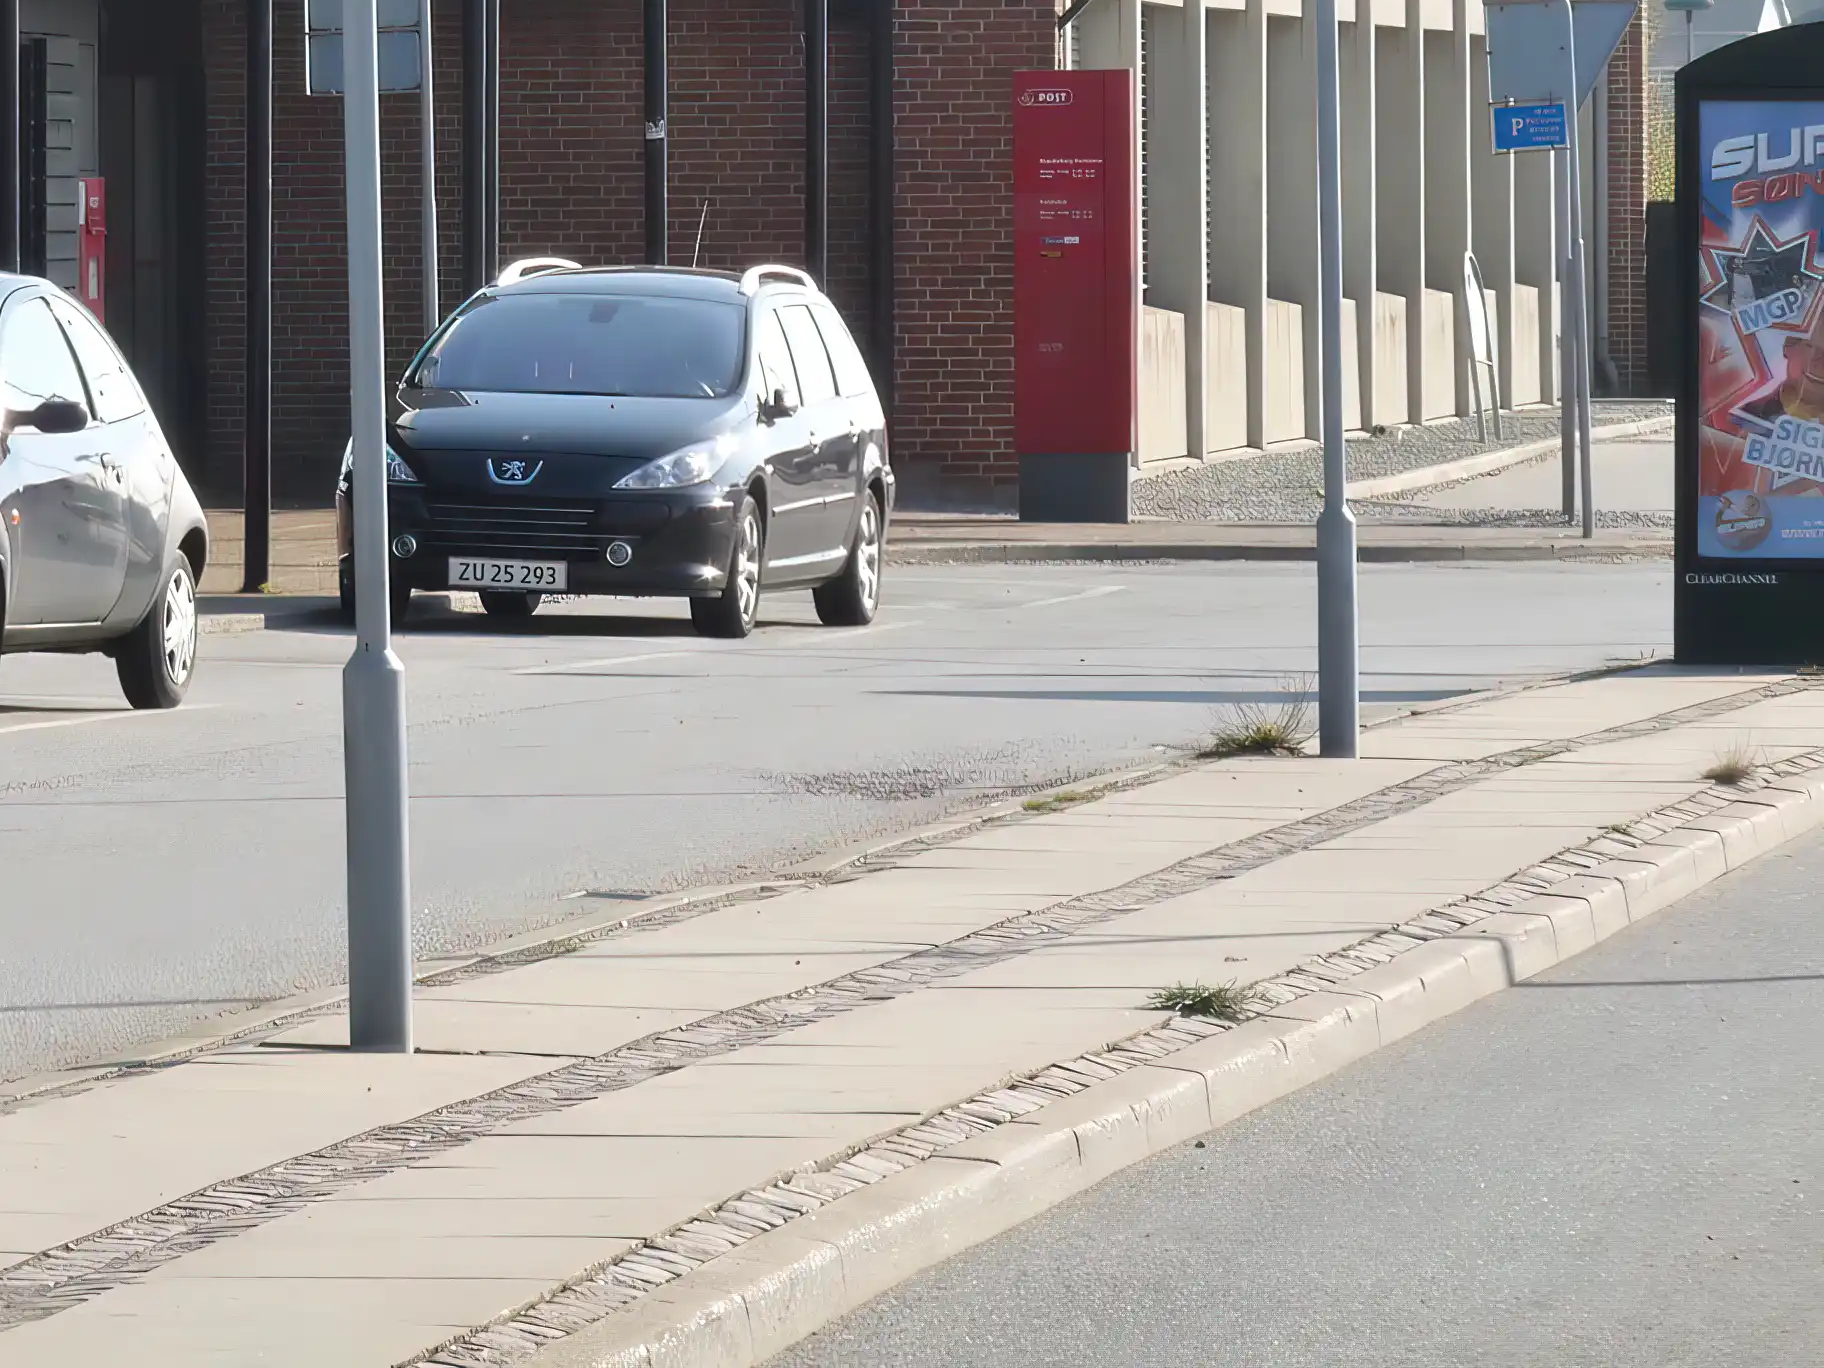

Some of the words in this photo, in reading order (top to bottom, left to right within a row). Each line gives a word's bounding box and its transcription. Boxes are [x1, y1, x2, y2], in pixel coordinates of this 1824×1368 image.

[1038, 93, 1066, 102] POST
[1512, 118, 1523, 136] P
[1739, 291, 1799, 330] MGP
[1777, 419, 1824, 448] SIG
[458, 562, 485, 581] ZU
[490, 564, 515, 583] 25
[520, 566, 556, 585] 293
